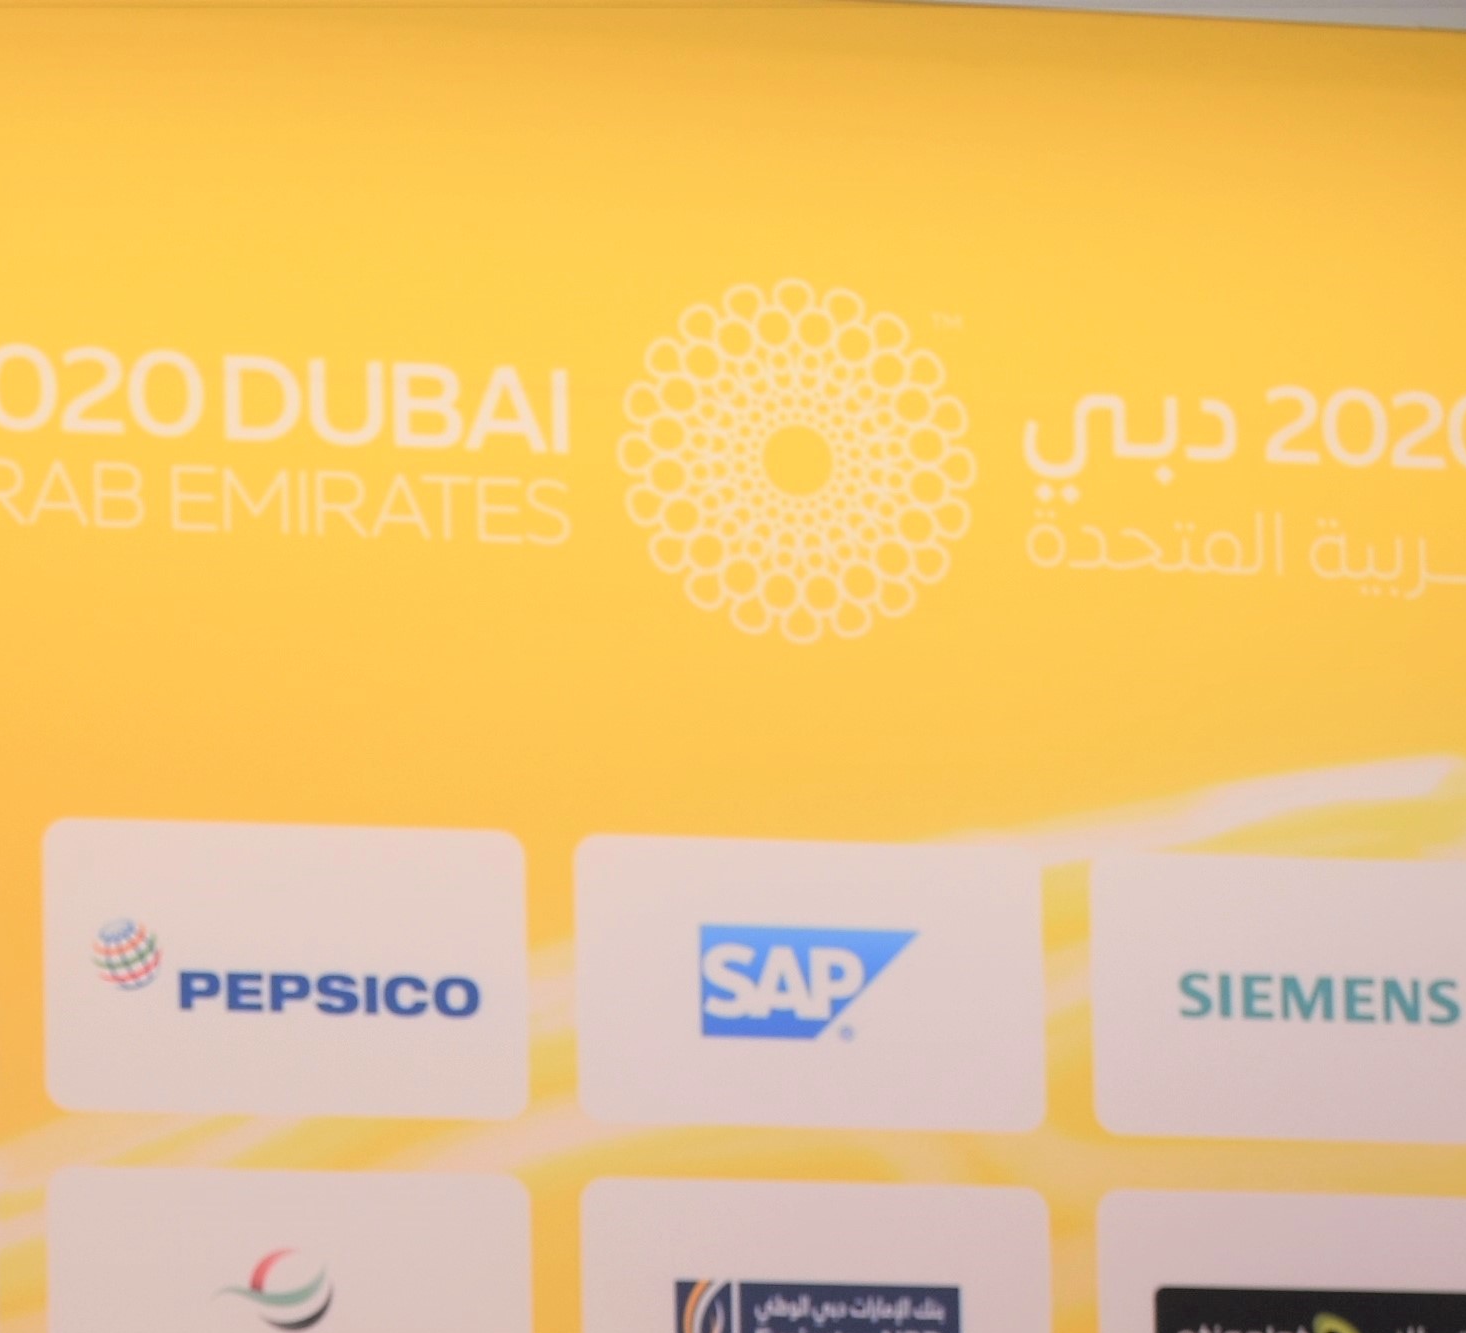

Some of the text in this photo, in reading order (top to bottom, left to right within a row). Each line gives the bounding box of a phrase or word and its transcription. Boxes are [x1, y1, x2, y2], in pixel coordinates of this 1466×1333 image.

[224, 355, 569, 454] DUBAI
[1024, 394, 1237, 503] دبي
[170, 464, 572, 546] EMIRATES
[1026, 509, 1284, 576] المتحدة
[179, 971, 480, 1018] PEPSICO
[702, 944, 863, 1019] SAP
[1180, 973, 1461, 1026] SIEMENS
